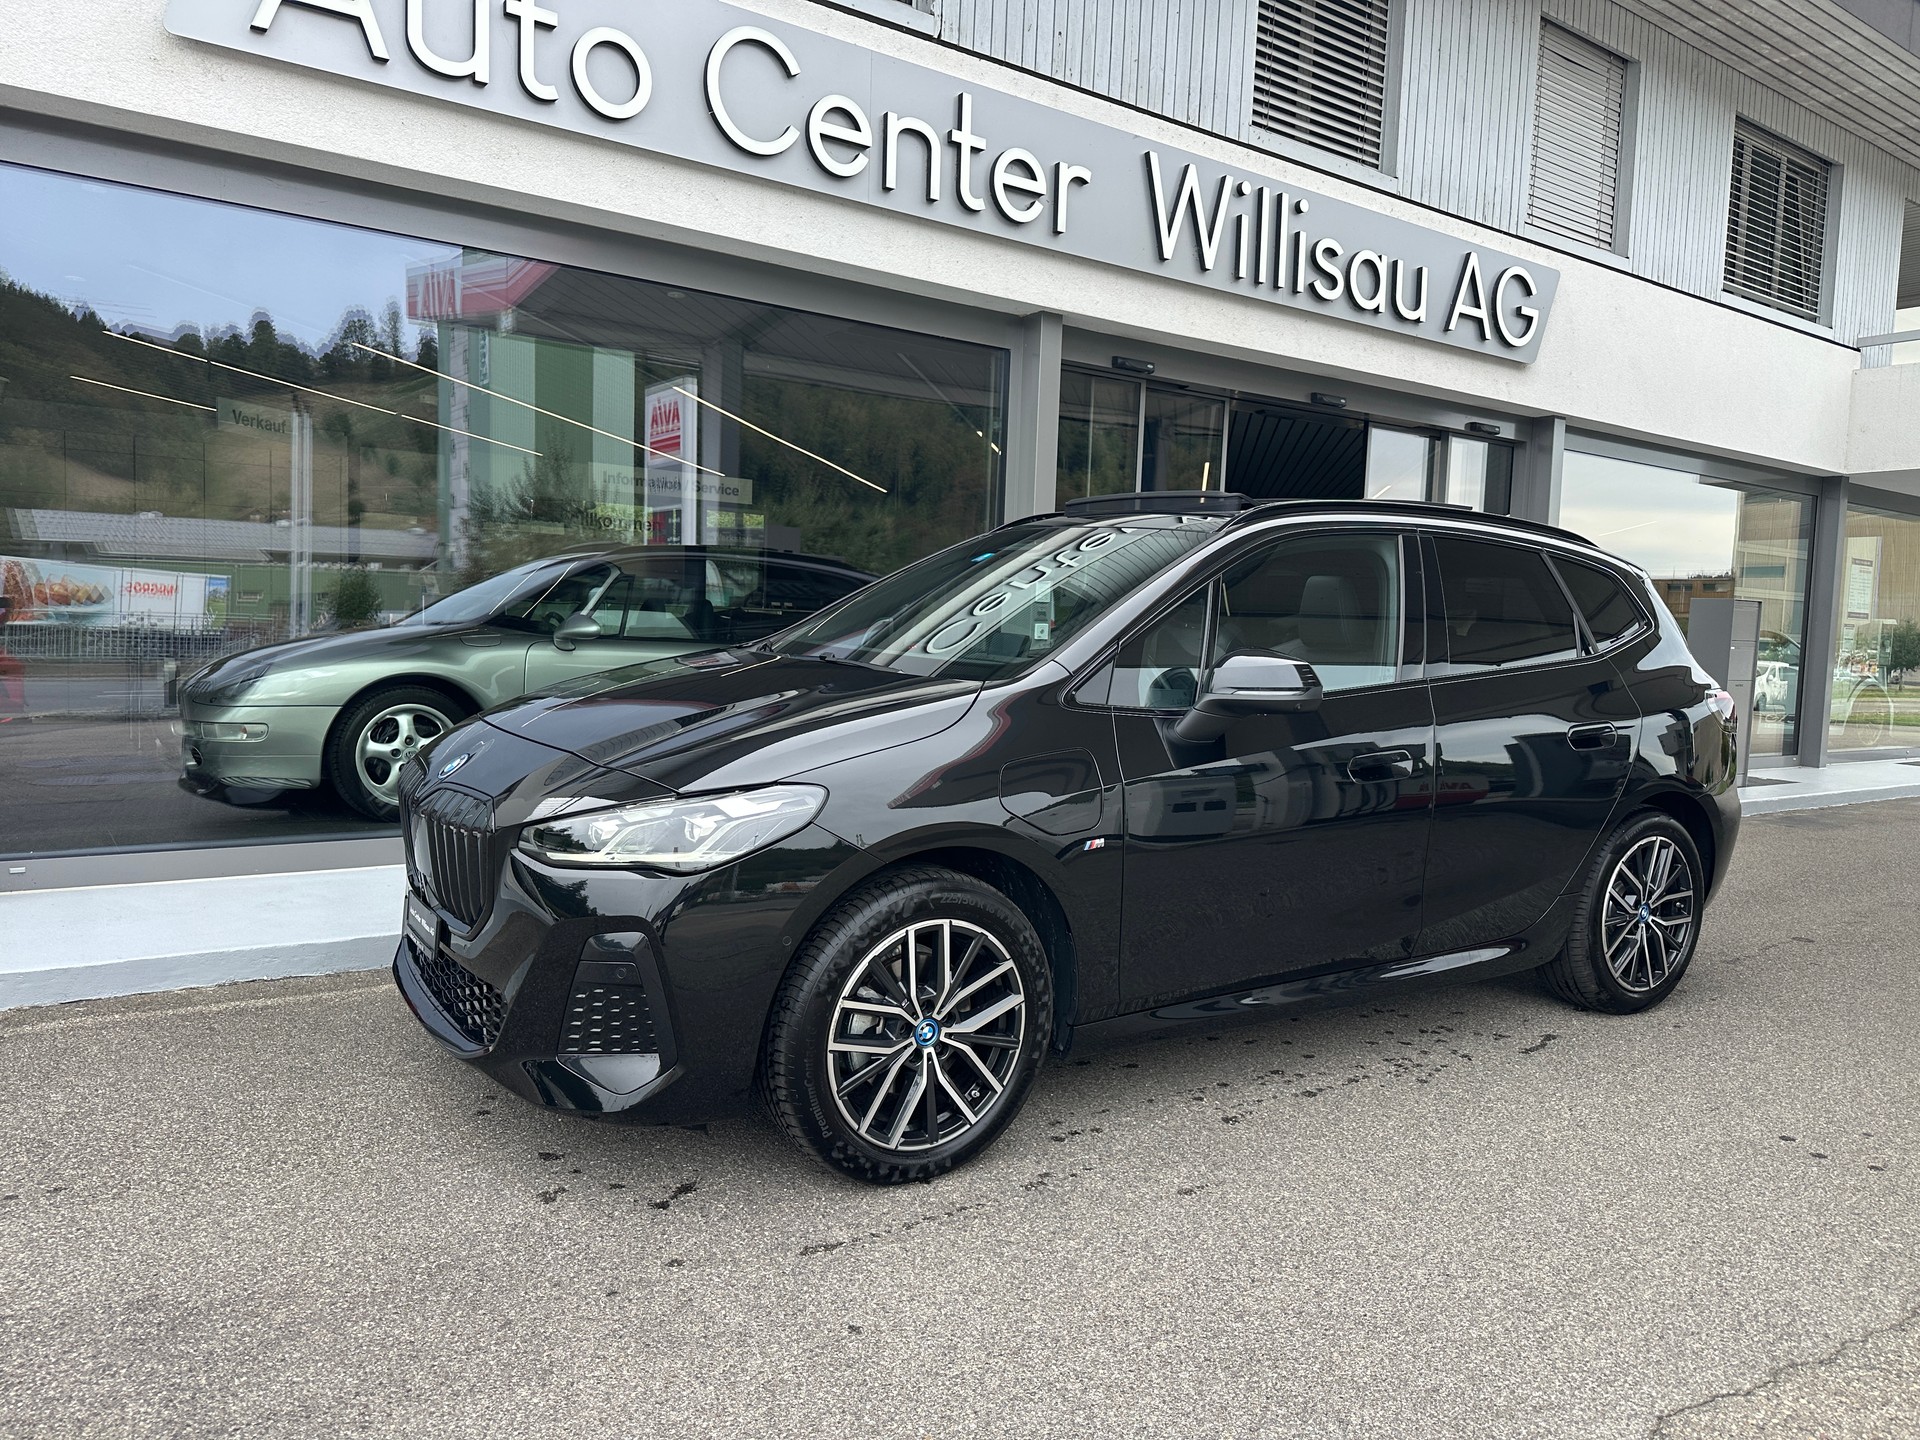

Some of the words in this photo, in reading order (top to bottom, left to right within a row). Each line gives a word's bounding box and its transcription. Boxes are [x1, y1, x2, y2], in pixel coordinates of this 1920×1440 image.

[703, 25, 1092, 234] Center
[1143, 150, 1429, 323] Willisau
[1445, 250, 1541, 348] AG
[232, 409, 287, 434] Verkauf
[692, 479, 740, 497] Service
